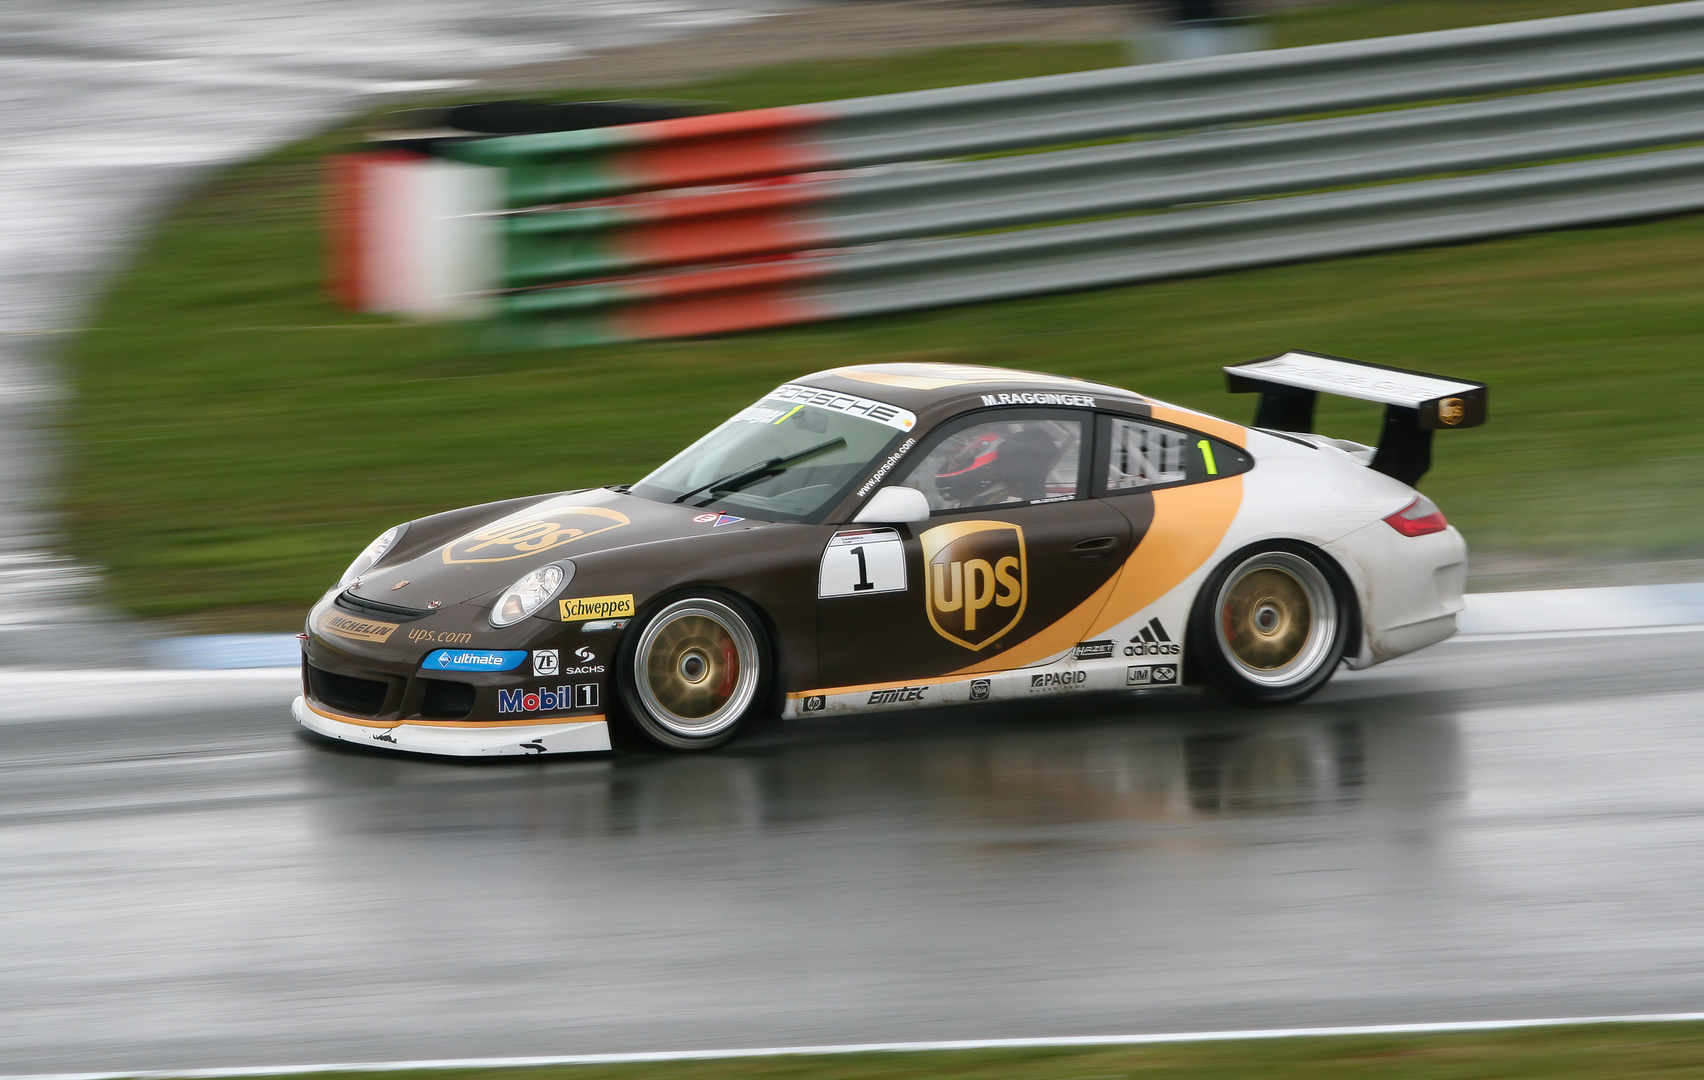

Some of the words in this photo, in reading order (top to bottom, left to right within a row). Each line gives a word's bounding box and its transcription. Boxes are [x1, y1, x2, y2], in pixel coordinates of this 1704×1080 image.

[981, 393, 1097, 407] M.RAGGINGER
[1197, 440, 1217, 474] 1
[857, 437, 916, 497] www.porsche.com
[850, 546, 874, 591] 1
[933, 556, 1021, 630] ups
[563, 599, 631, 619] Schweppes
[328, 616, 394, 636] MICHELIN
[408, 628, 472, 644] ups.com
[1123, 641, 1180, 657] adidas
[453, 651, 503, 665] ultimate
[538, 655, 557, 669] ZF
[566, 665, 605, 675] SACHS
[1044, 670, 1087, 687] PAGID
[1130, 669, 1149, 682] JM
[498, 685, 571, 713] Mobil
[582, 686, 592, 705] 1
